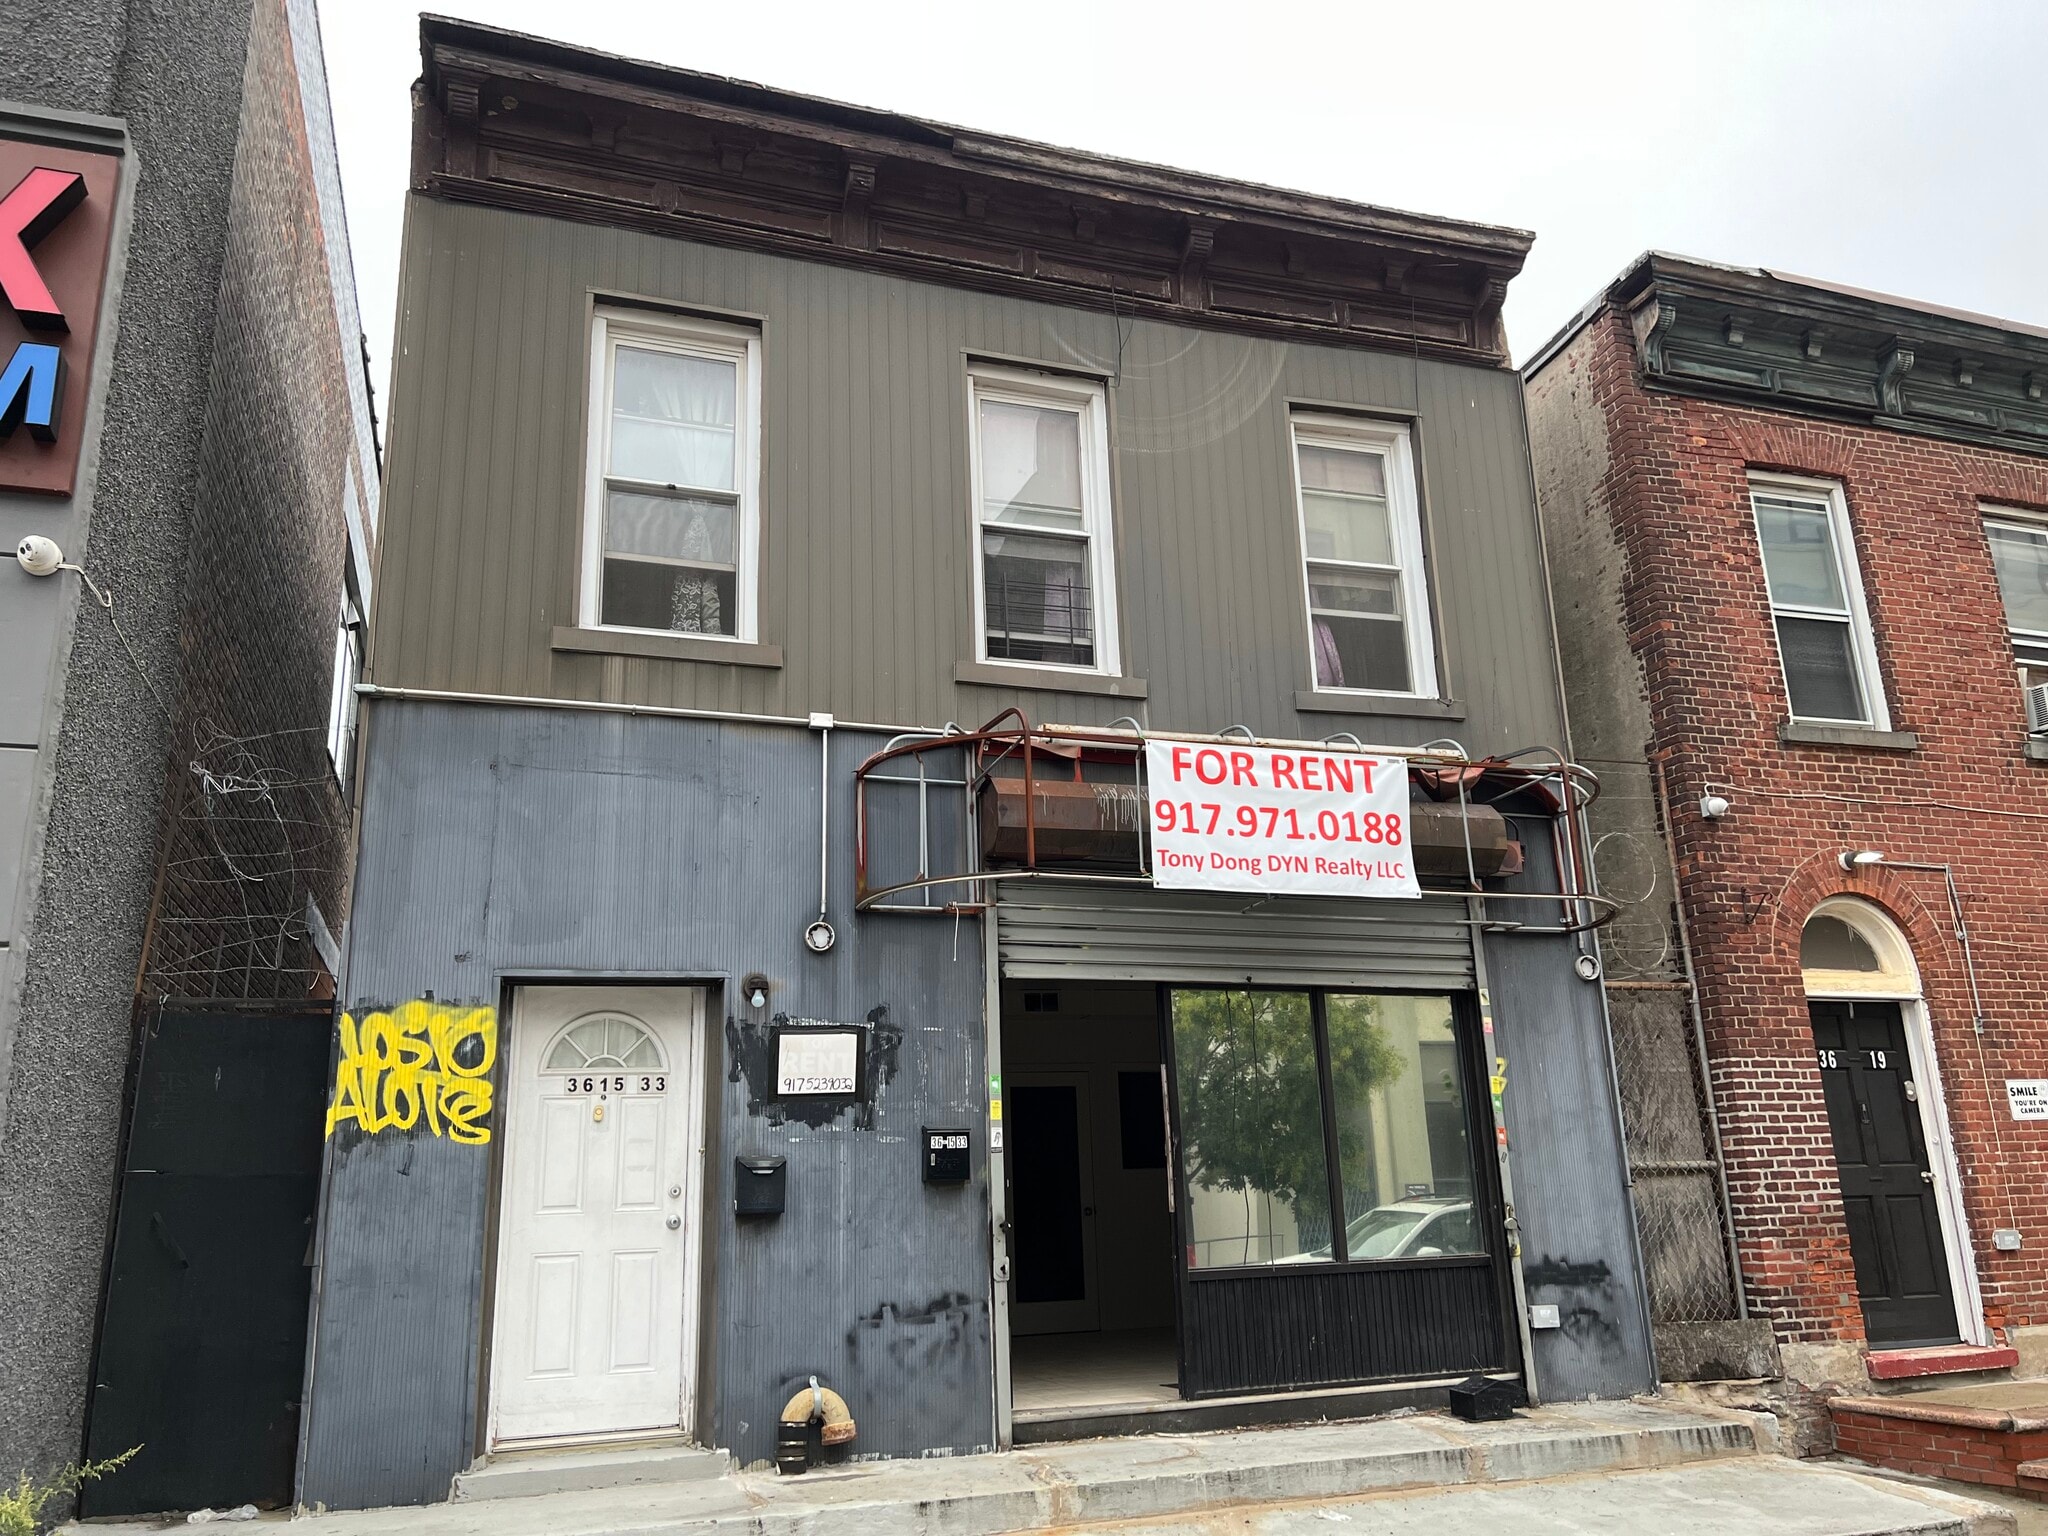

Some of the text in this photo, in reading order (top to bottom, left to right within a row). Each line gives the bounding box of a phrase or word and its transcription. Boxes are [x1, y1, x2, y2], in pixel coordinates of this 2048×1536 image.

[1172, 746, 1378, 794] FOR RENT
[1155, 799, 1403, 846] 917.971.0188
[1157, 849, 1406, 880] Tony Dong DYN Realty LLC
[1819, 1050, 1887, 1069] 36 19
[567, 1076, 665, 1092] 3615 33
[2010, 1087, 2038, 1097] SMILE
[957, 1136, 967, 1148] 33
